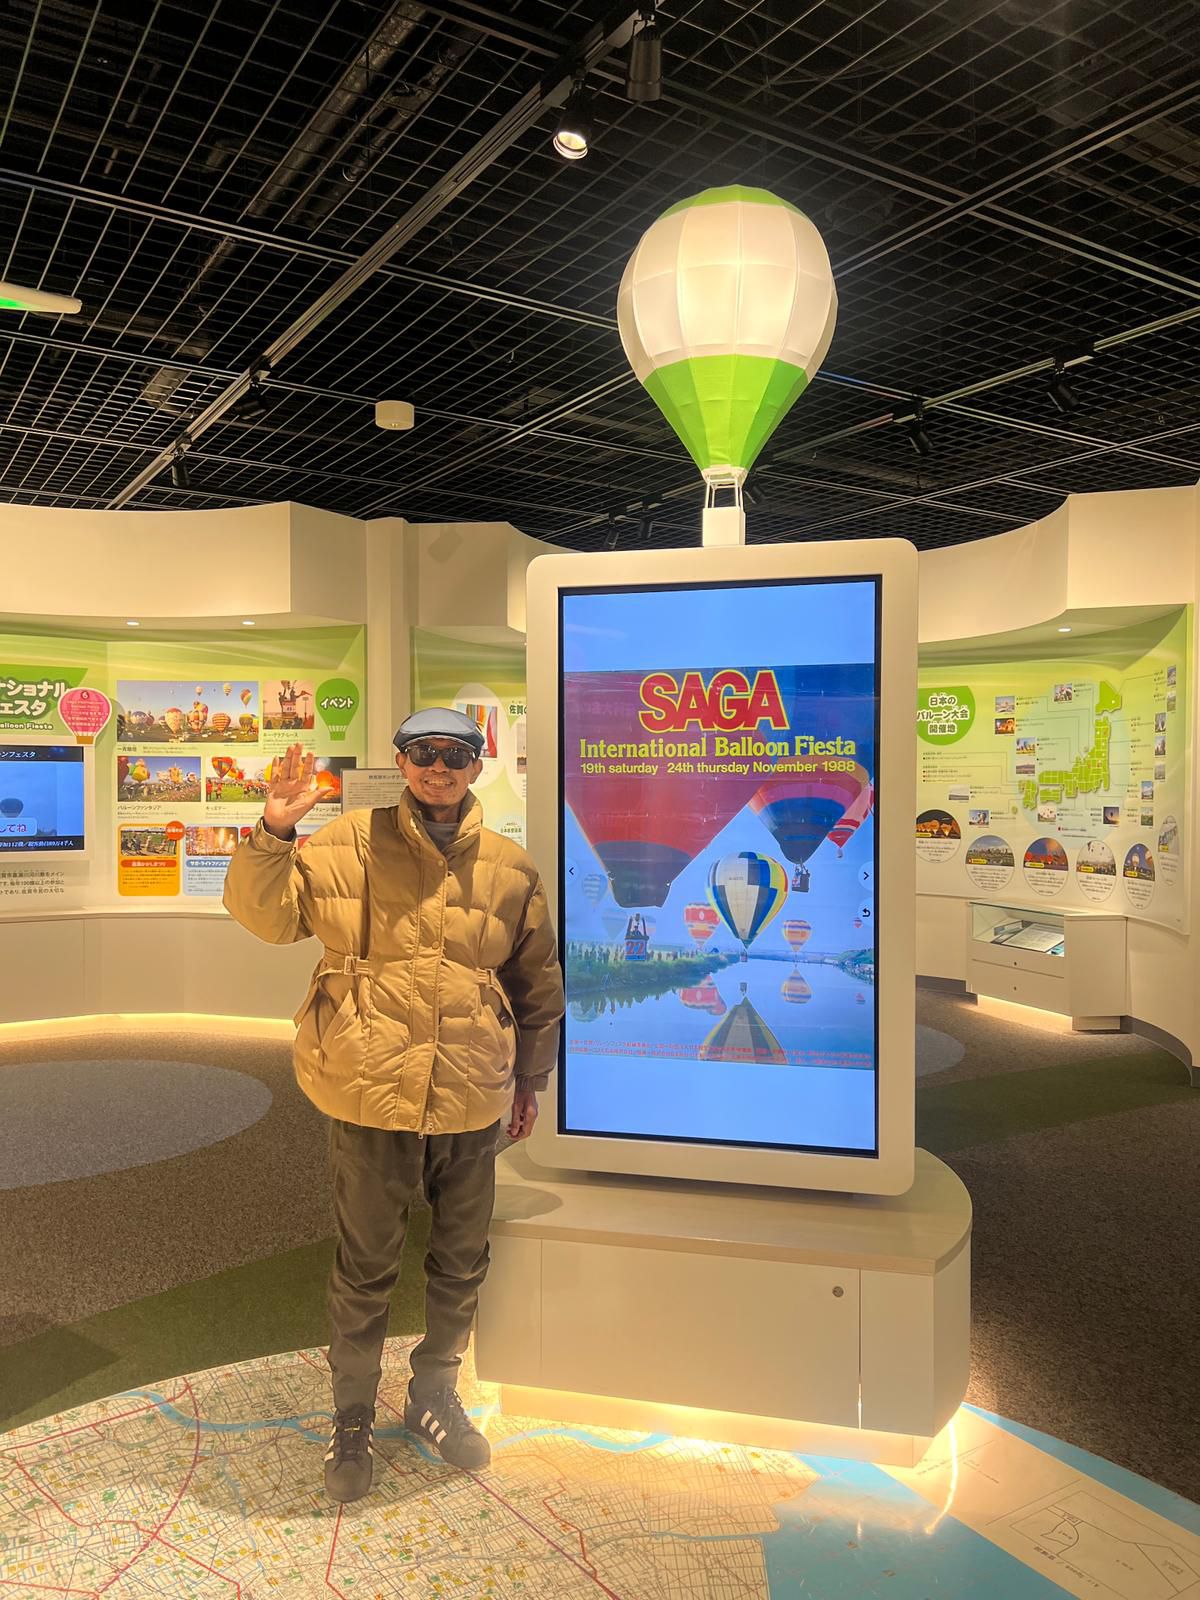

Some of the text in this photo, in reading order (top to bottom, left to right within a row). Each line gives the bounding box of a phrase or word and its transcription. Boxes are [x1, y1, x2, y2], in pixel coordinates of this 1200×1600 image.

[81, 690, 89, 699] 6
[321, 697, 354, 709] イベント
[638, 669, 790, 733] SAGA
[929, 696, 957, 706] 日本の
[917, 709, 969, 720] バルーン大会
[929, 724, 956, 733] 開催地
[580, 735, 857, 758] International Balloon Fiesta
[581, 760, 856, 776] 19th saturday 24th thursday November 1988
